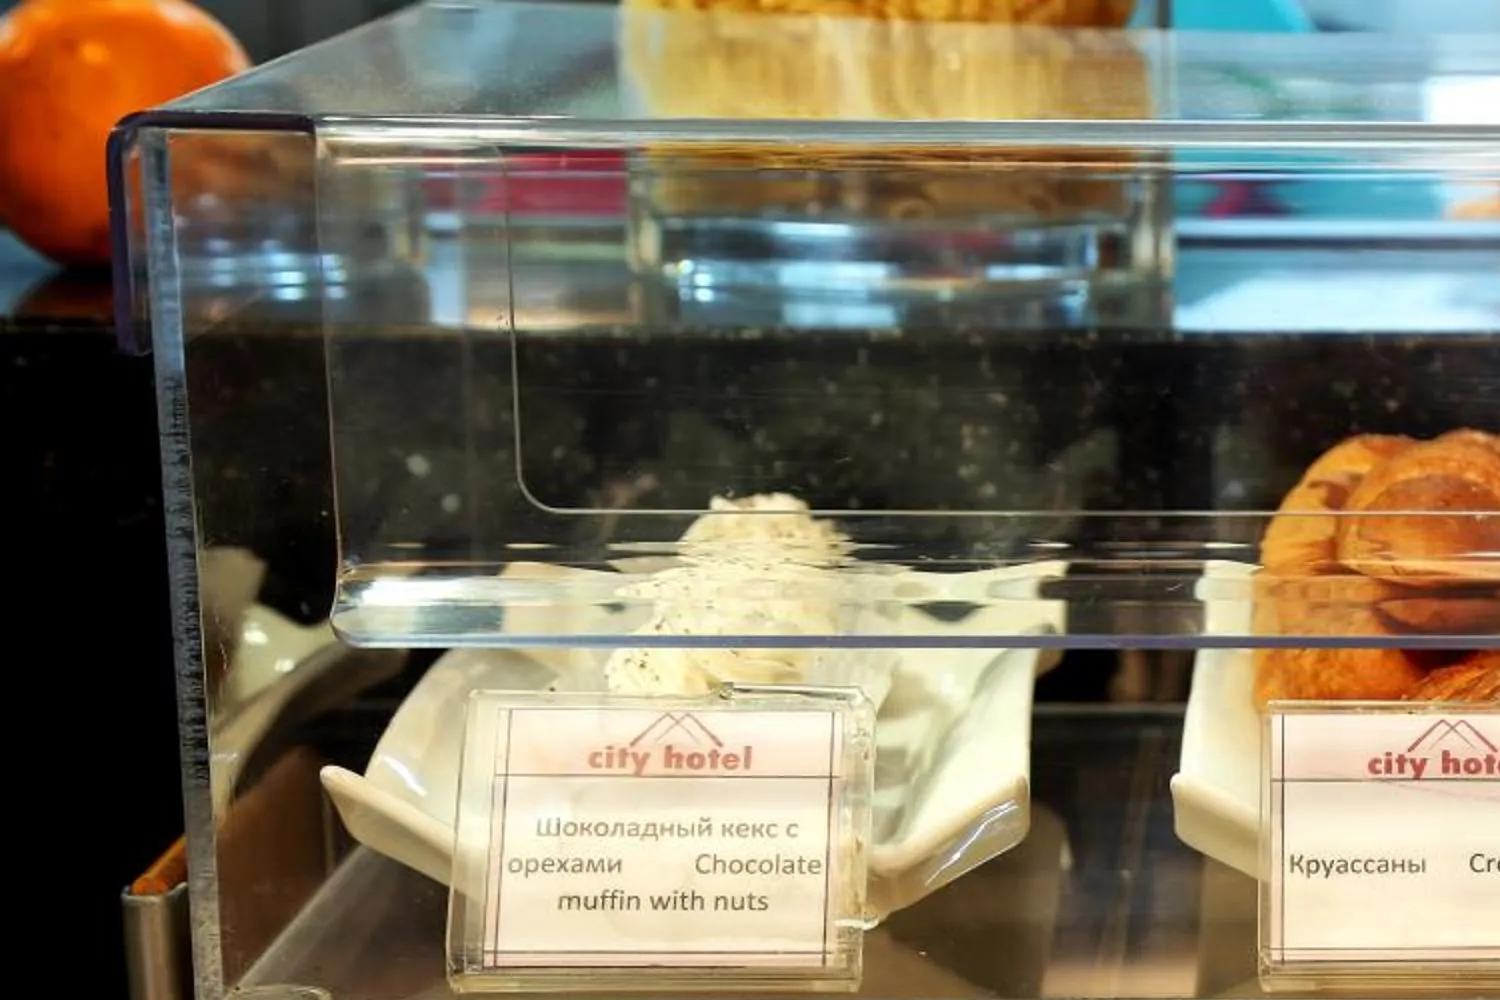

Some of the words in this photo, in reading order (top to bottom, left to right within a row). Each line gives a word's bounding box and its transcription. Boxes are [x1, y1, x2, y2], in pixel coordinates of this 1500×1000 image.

[588, 746, 650, 775] city
[664, 745, 753, 770] hotel
[1367, 752, 1428, 779] city
[536, 817, 713, 841] Шоколадный
[722, 823, 778, 838] кекс
[786, 823, 799, 838] с
[508, 857, 623, 877] орехами
[695, 853, 822, 875] Chocolate
[1290, 854, 1427, 879] Круассаны
[557, 891, 641, 911] muffin
[649, 891, 705, 911] with
[714, 891, 769, 911] nuts
